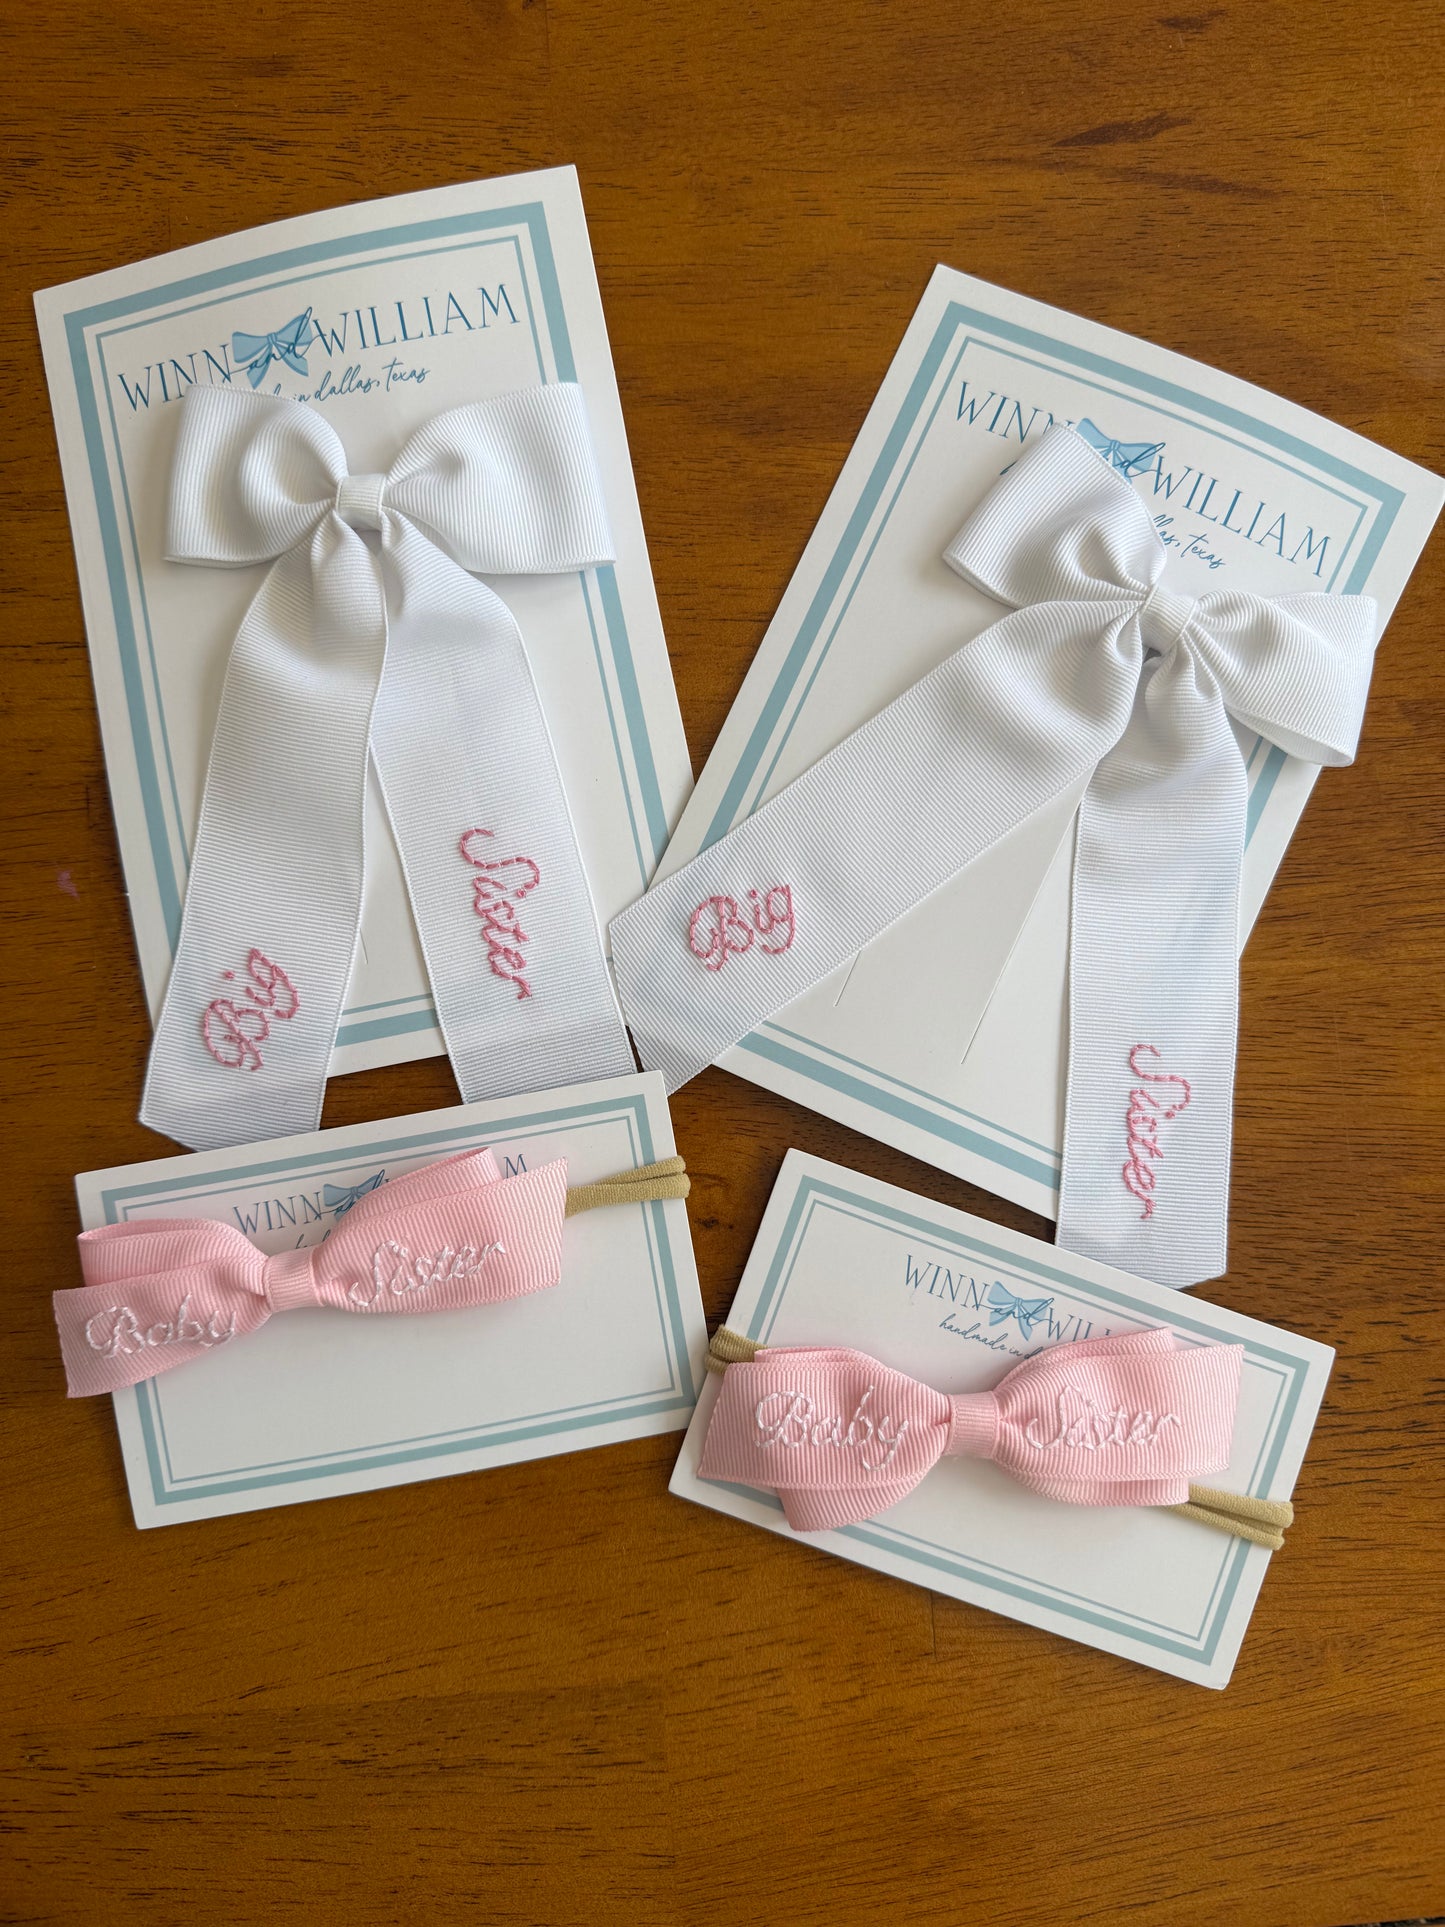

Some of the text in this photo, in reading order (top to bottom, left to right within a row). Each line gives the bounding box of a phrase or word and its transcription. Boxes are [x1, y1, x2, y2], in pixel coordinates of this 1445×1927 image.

[118, 344, 233, 412] WINN
[312, 282, 521, 359] WILLIAM
[314, 363, 380, 402] dallas,
[381, 357, 431, 392] texas
[1152, 454, 1332, 578] WILLIAM
[1180, 533, 1226, 569] texas
[458, 827, 541, 1001] Sister
[689, 884, 796, 972] Big
[202, 946, 301, 1071] Big
[1122, 1043, 1192, 1220] Sister
[233, 1191, 323, 1235] WINN
[85, 1239, 506, 1359] Baby Sister
[904, 1254, 990, 1311] WINN
[938, 1313, 1009, 1351] handmade
[1008, 1346, 1023, 1357] in
[754, 1384, 1184, 1472] Baby Sister
